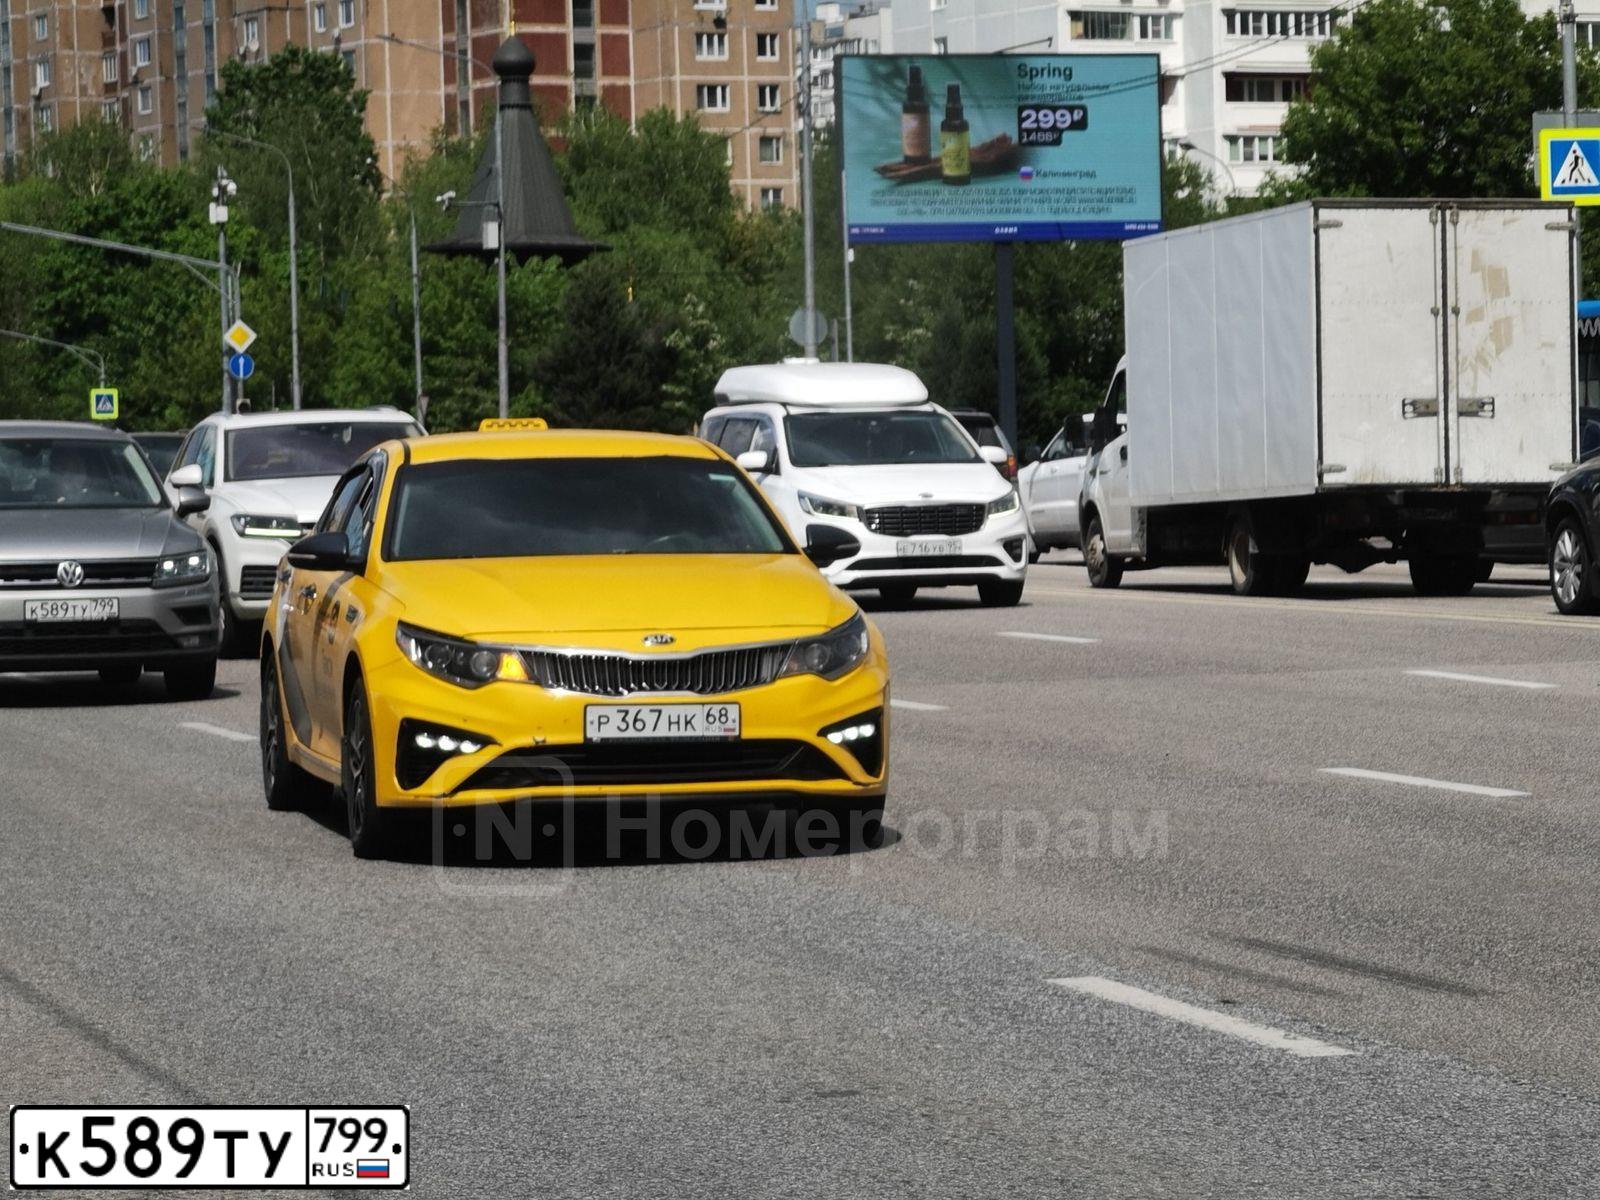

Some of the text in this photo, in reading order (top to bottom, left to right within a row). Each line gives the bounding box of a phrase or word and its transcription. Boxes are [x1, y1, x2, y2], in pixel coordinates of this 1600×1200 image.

[1017, 63, 1073, 82] Spring
[30, 599, 114, 617] К589ТУ 799
[597, 707, 729, 732] Р367НК 68
